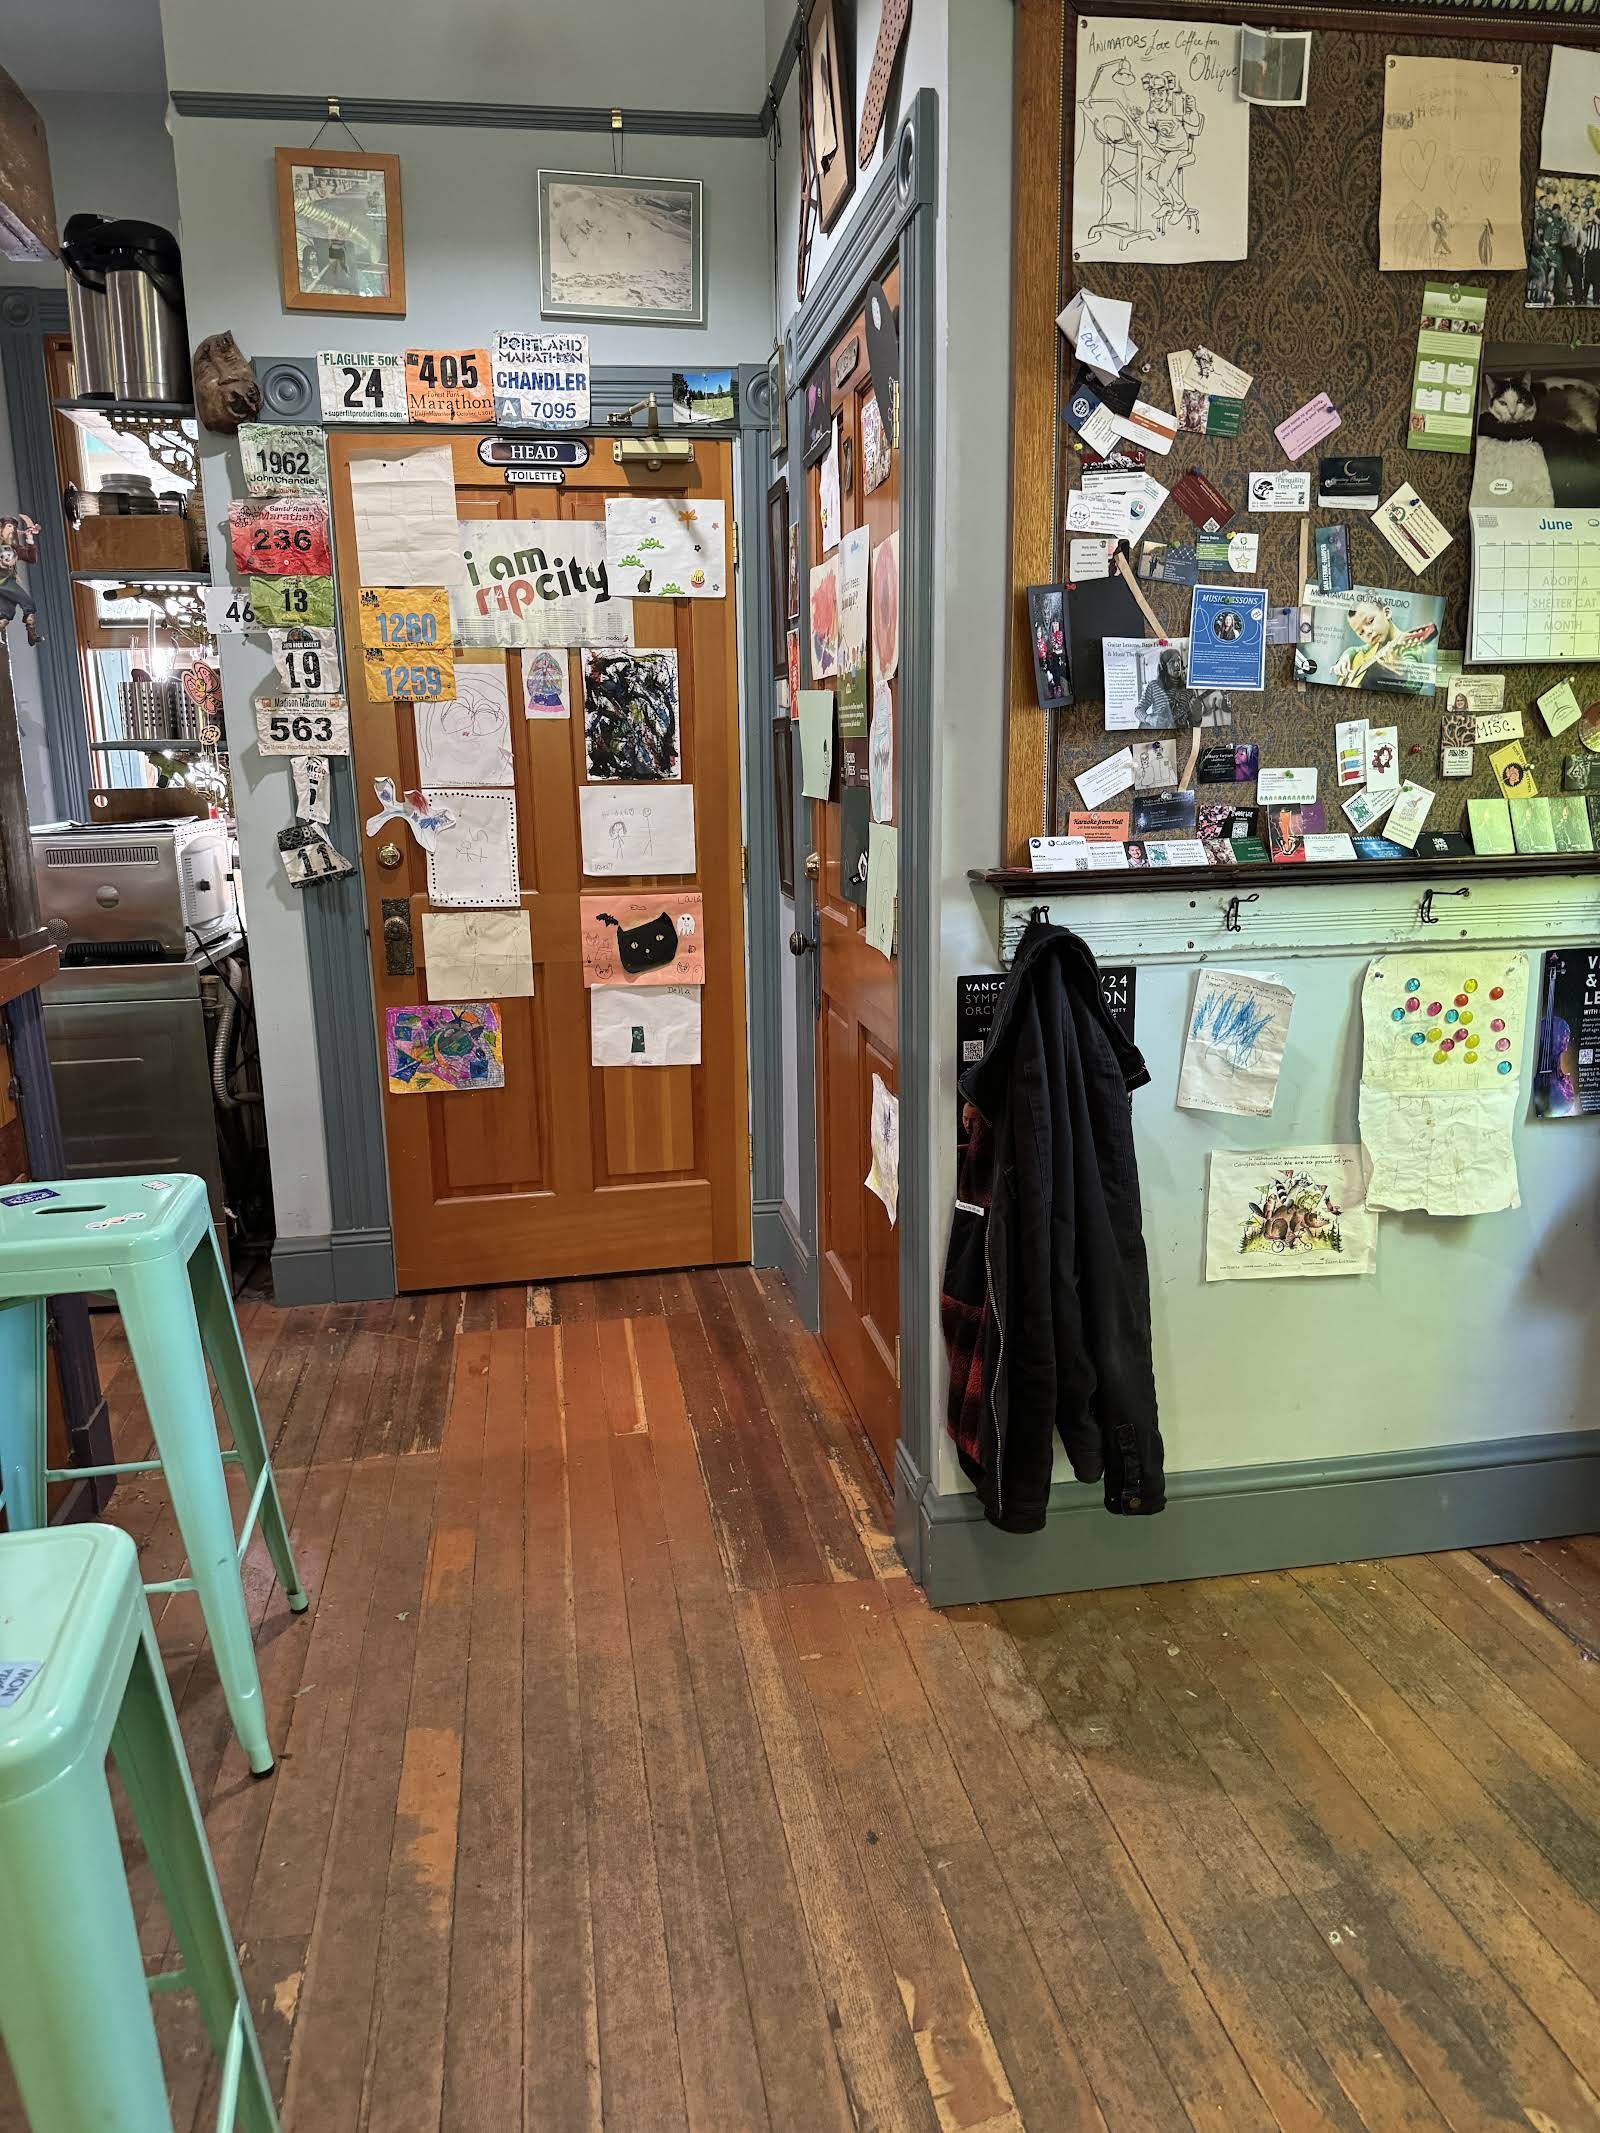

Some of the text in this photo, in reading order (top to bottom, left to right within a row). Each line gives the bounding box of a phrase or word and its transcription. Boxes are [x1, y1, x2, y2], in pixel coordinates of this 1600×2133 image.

[1089, 32, 1147, 53] ANIMATORS
[1145, 29, 1170, 55] Love
[1175, 30, 1203, 55] Coffee
[1189, 52, 1239, 92] Oblique
[500, 336, 582, 351] PORTLAND
[323, 353, 399, 365] FLAGLINE 50K
[499, 351, 583, 364] MARATHON
[419, 353, 478, 388] 405
[342, 367, 384, 408] 24
[497, 372, 586, 391] CHANDLER
[410, 394, 492, 410] Marathon
[502, 400, 577, 419] A 7095
[328, 409, 403, 418] superfitproductions.com
[510, 444, 558, 460] HEAD
[257, 449, 310, 475] 1962
[250, 474, 319, 485] John Chandler
[510, 471, 558, 481] TOILETTE
[259, 511, 315, 521] Marathon
[1539, 518, 1573, 531] June
[254, 528, 312, 551] 236
[488, 547, 549, 581] am
[1542, 576, 1589, 587] ADOPT A
[281, 588, 308, 613] 13
[1201, 594, 1225, 603] MUSIC
[1383, 598, 1410, 609] STUDIO
[1532, 599, 1597, 609] SHELTER CAT
[225, 601, 255, 623] 46
[376, 612, 437, 642] 1260
[1544, 620, 1583, 631] MONTH
[285, 651, 321, 688] 19
[381, 666, 442, 697] 1259
[274, 697, 327, 708] Madison Marathon
[270, 716, 333, 742] 563
[1476, 720, 1516, 738] Misc.
[1096, 818, 1111, 826] from
[297, 843, 337, 877] 11
[1588, 956, 1600, 970] V
[1585, 974, 1598, 988] &
[667, 985, 690, 996] Della
[965, 994, 998, 1004] SYMP
[1314, 1158, 1332, 1167] proud
